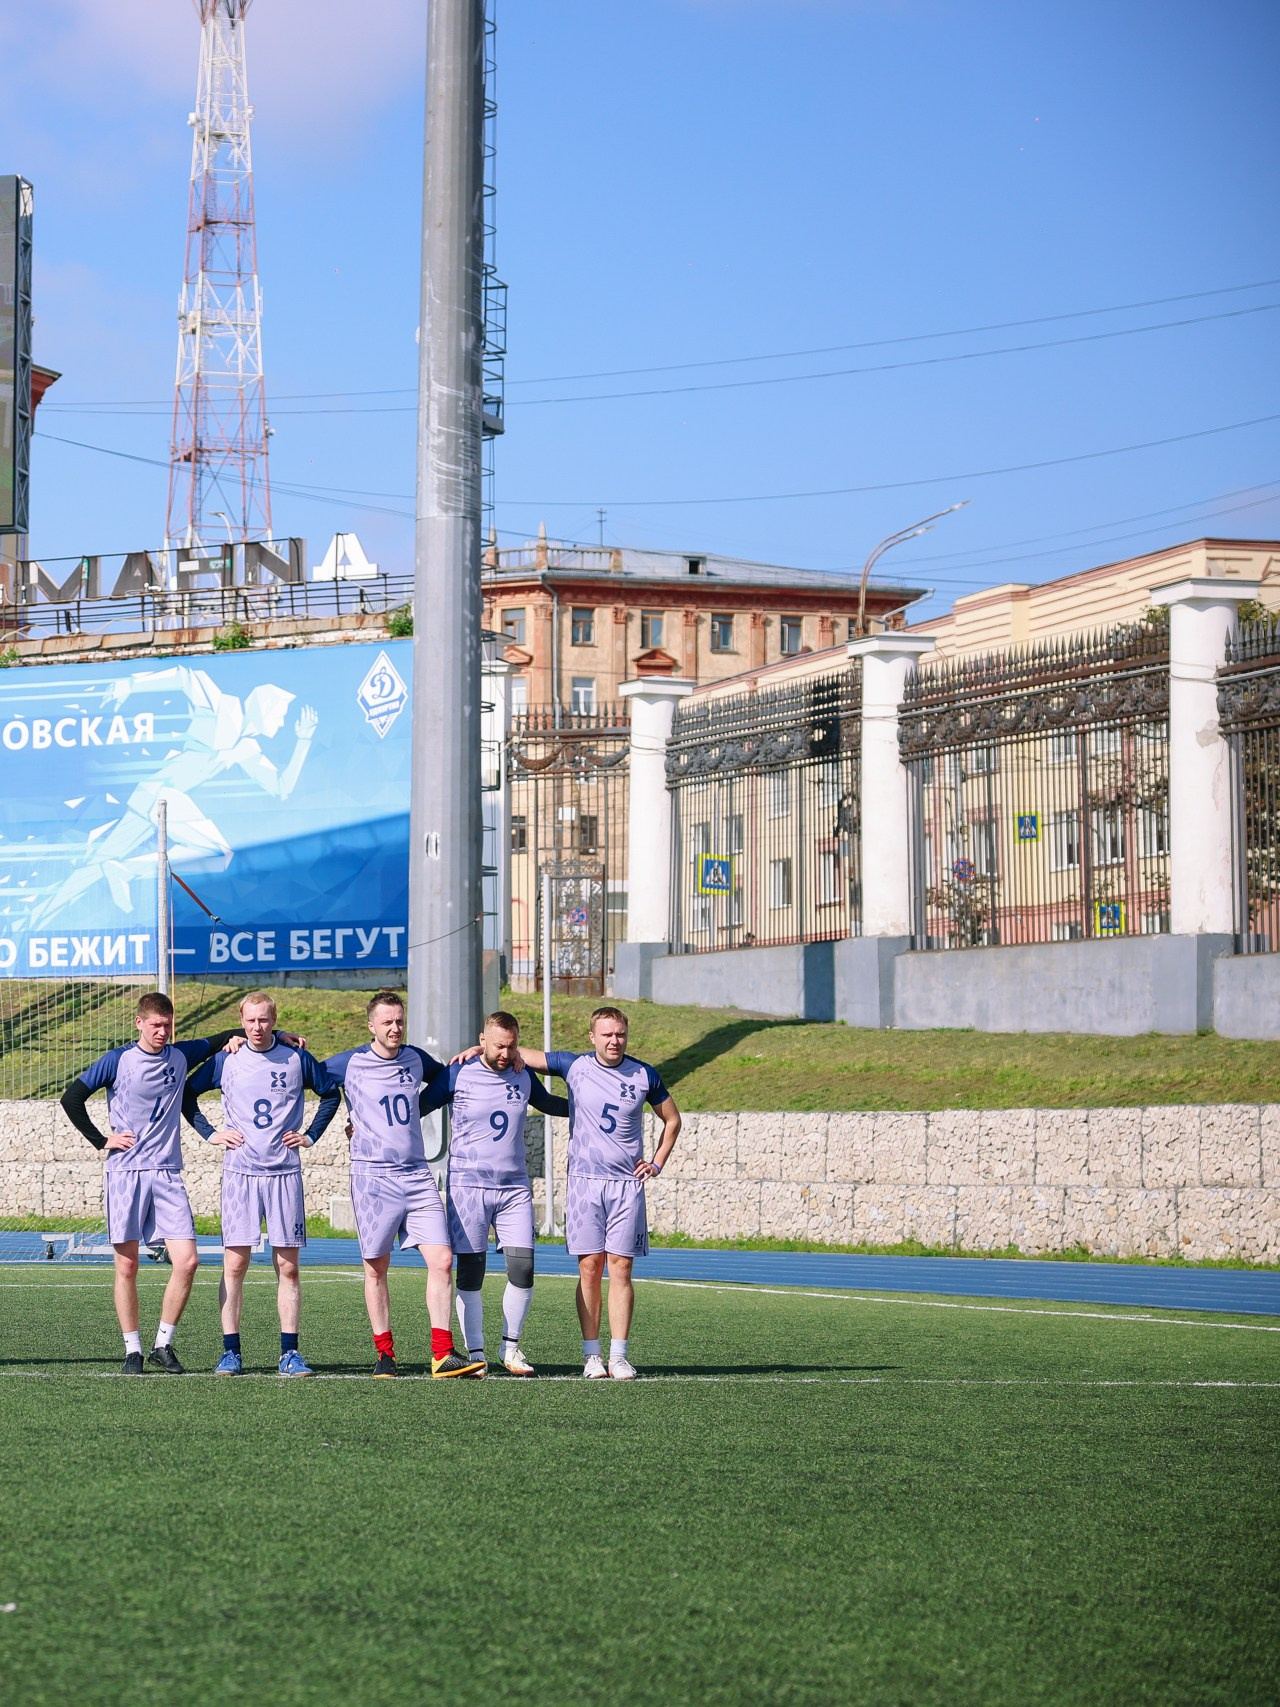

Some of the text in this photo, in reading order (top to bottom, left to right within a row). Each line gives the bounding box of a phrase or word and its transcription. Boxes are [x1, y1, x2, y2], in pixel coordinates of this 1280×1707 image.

[29, 934, 150, 968] БЕЖИТ
[209, 930, 276, 963] ВСЕ
[290, 926, 405, 960] БЕГУТ
[253, 1098, 273, 1130] 8
[378, 1093, 411, 1127] 10
[489, 1110, 509, 1142] 9
[599, 1102, 620, 1134] 5
